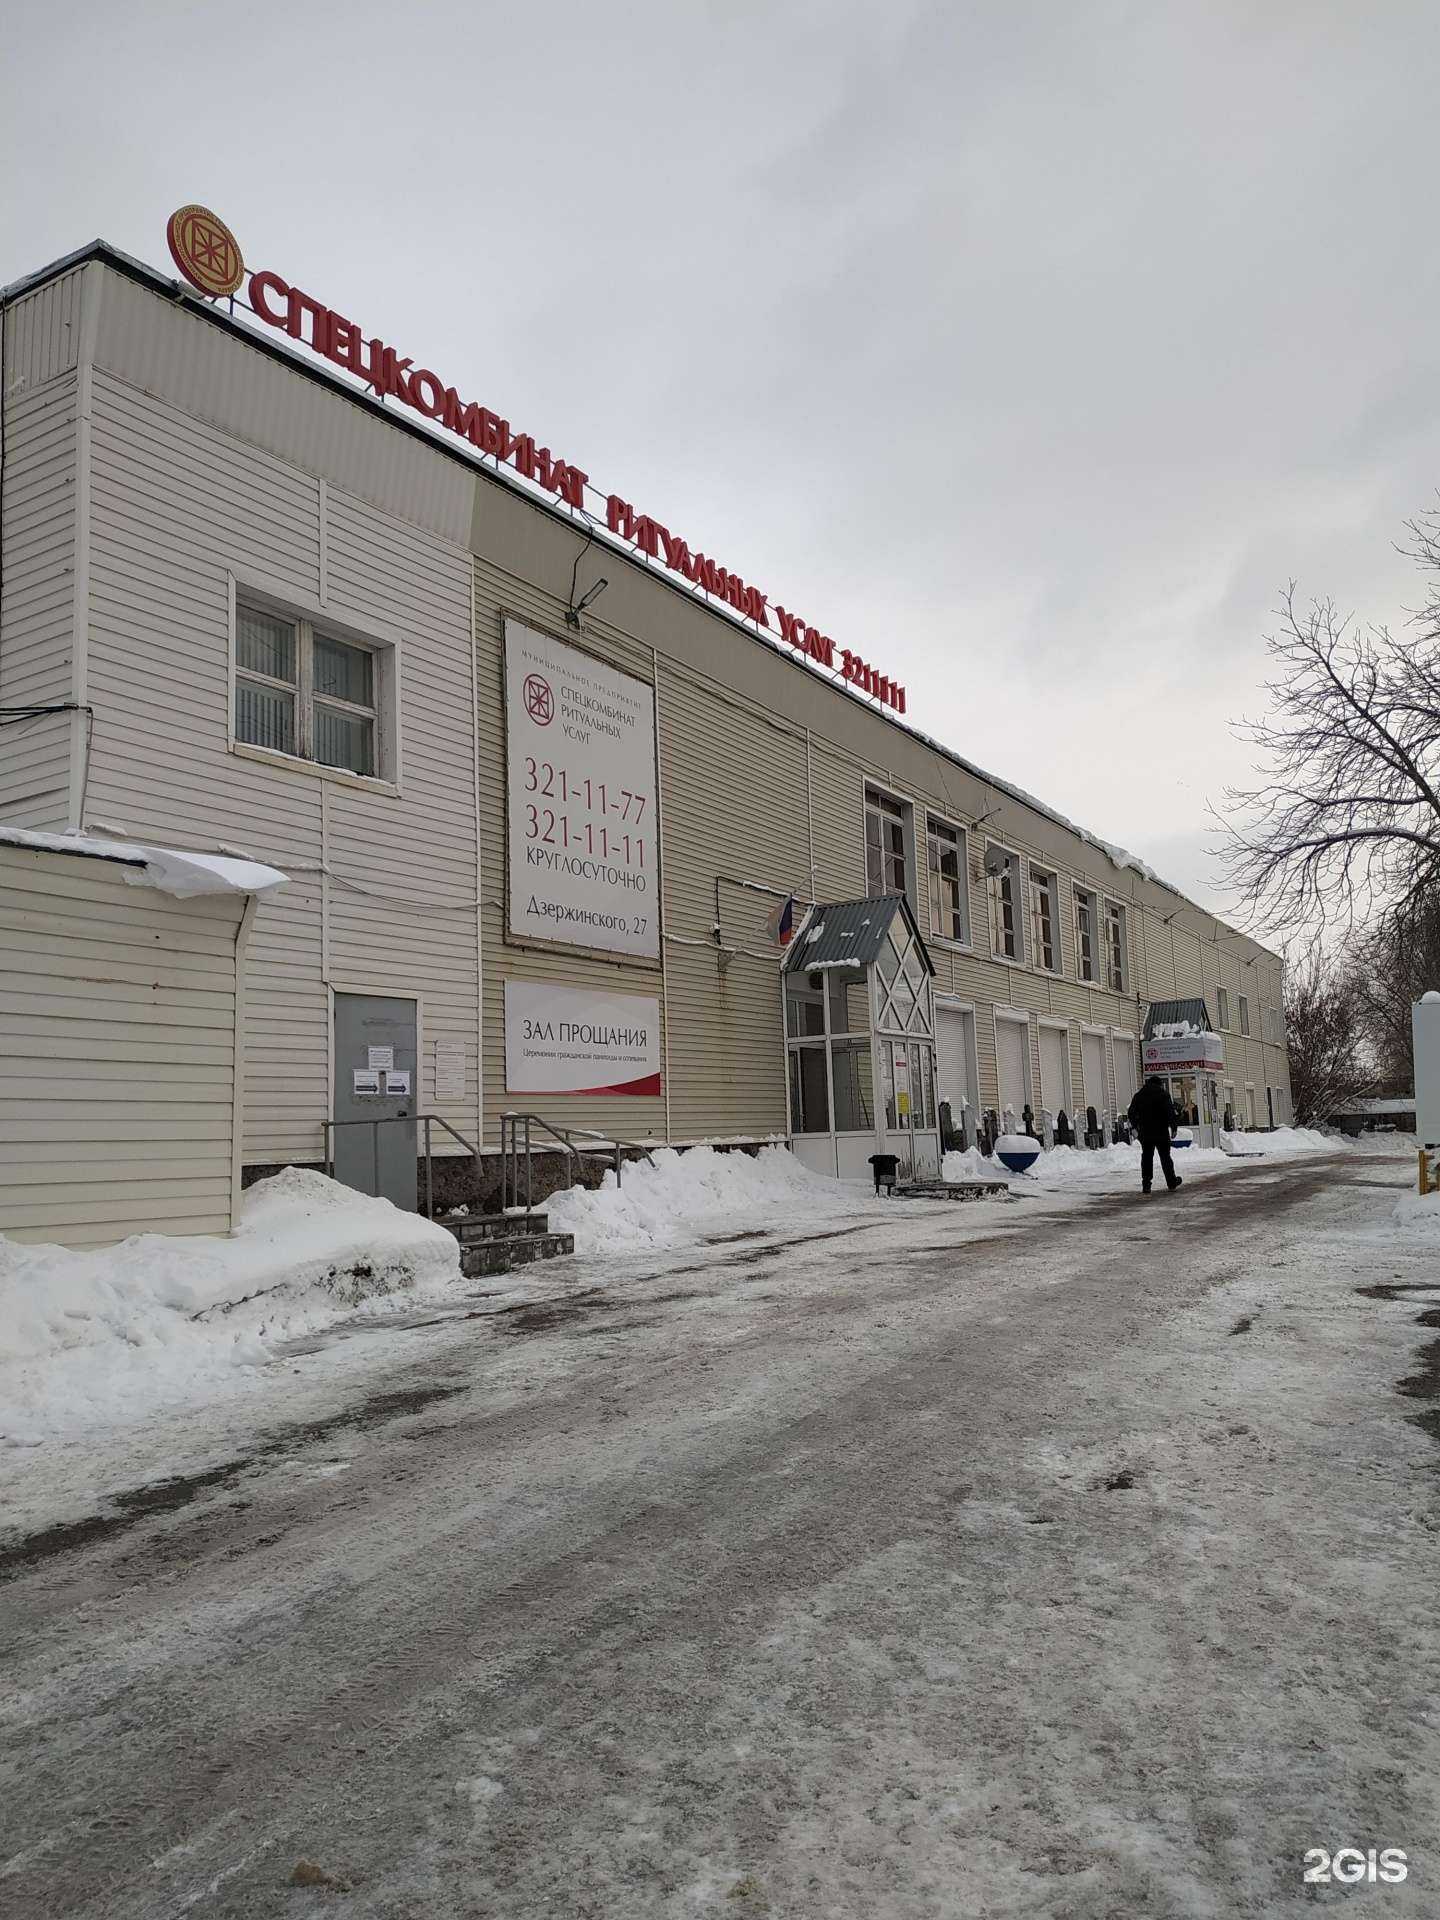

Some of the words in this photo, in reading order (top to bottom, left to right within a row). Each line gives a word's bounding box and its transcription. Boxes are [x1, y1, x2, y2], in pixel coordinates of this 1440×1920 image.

[248, 270, 589, 510] СПЕЦКОМБИНАТ
[606, 494, 769, 627] РИТУАЛЬНЫХ
[775, 605, 836, 668] УСЛУГ
[840, 649, 907, 714] 3211111
[560, 686, 637, 728] СПЕЦКОМБИНАТ
[561, 704, 622, 740] РИТУАЛЬНЫХ
[562, 723, 591, 745] УСЛУГ
[524, 757, 646, 825] 321-11-77
[525, 804, 644, 868] 321-11-11
[526, 846, 647, 892] КРУГЛОСУТОЧНО
[526, 895, 630, 936] Дзержинского,
[633, 917, 648, 935] 27
[522, 1019, 555, 1041] ЗАЛ
[559, 1023, 647, 1047] ПРОЩАНИЯ
